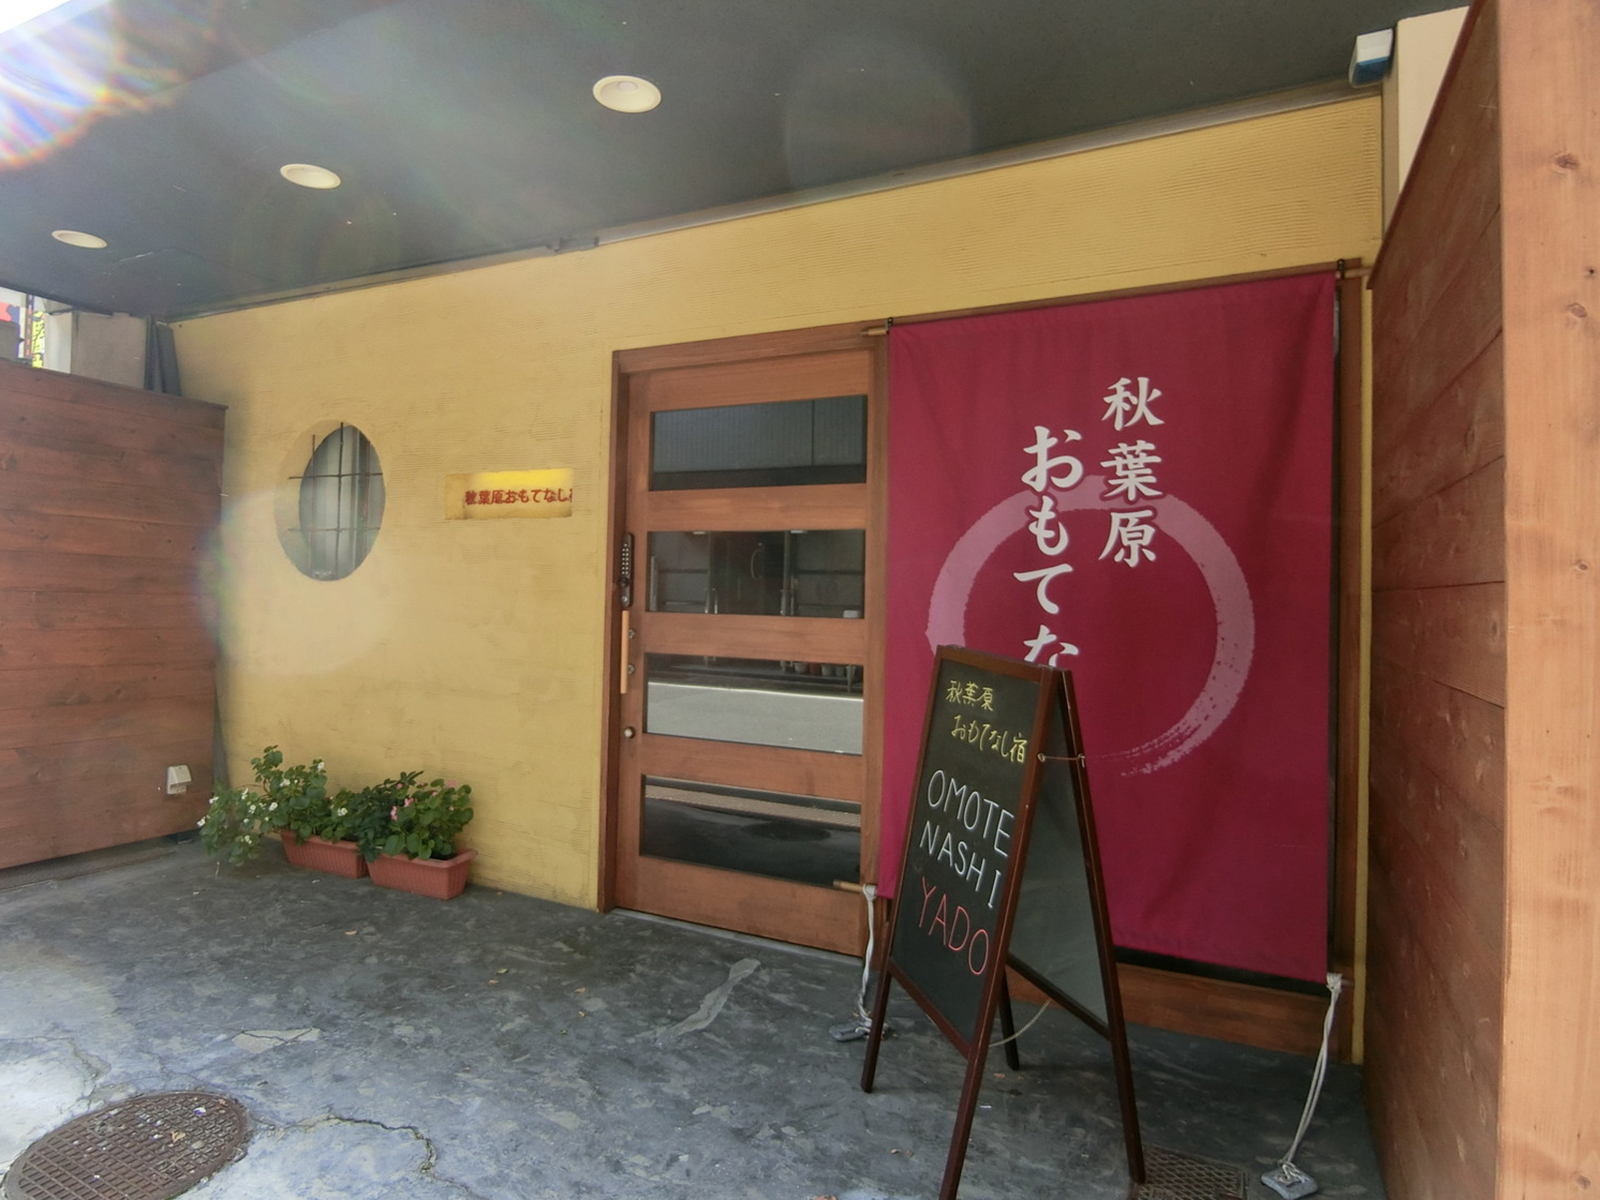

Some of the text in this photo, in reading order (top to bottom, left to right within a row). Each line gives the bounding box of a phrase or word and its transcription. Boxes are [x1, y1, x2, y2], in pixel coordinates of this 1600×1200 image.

[1098, 376, 1165, 568] 秋葉原
[951, 714, 1028, 763] おもてなし宿
[927, 769, 1014, 857] OMOTE
[918, 876, 989, 976] YADO
